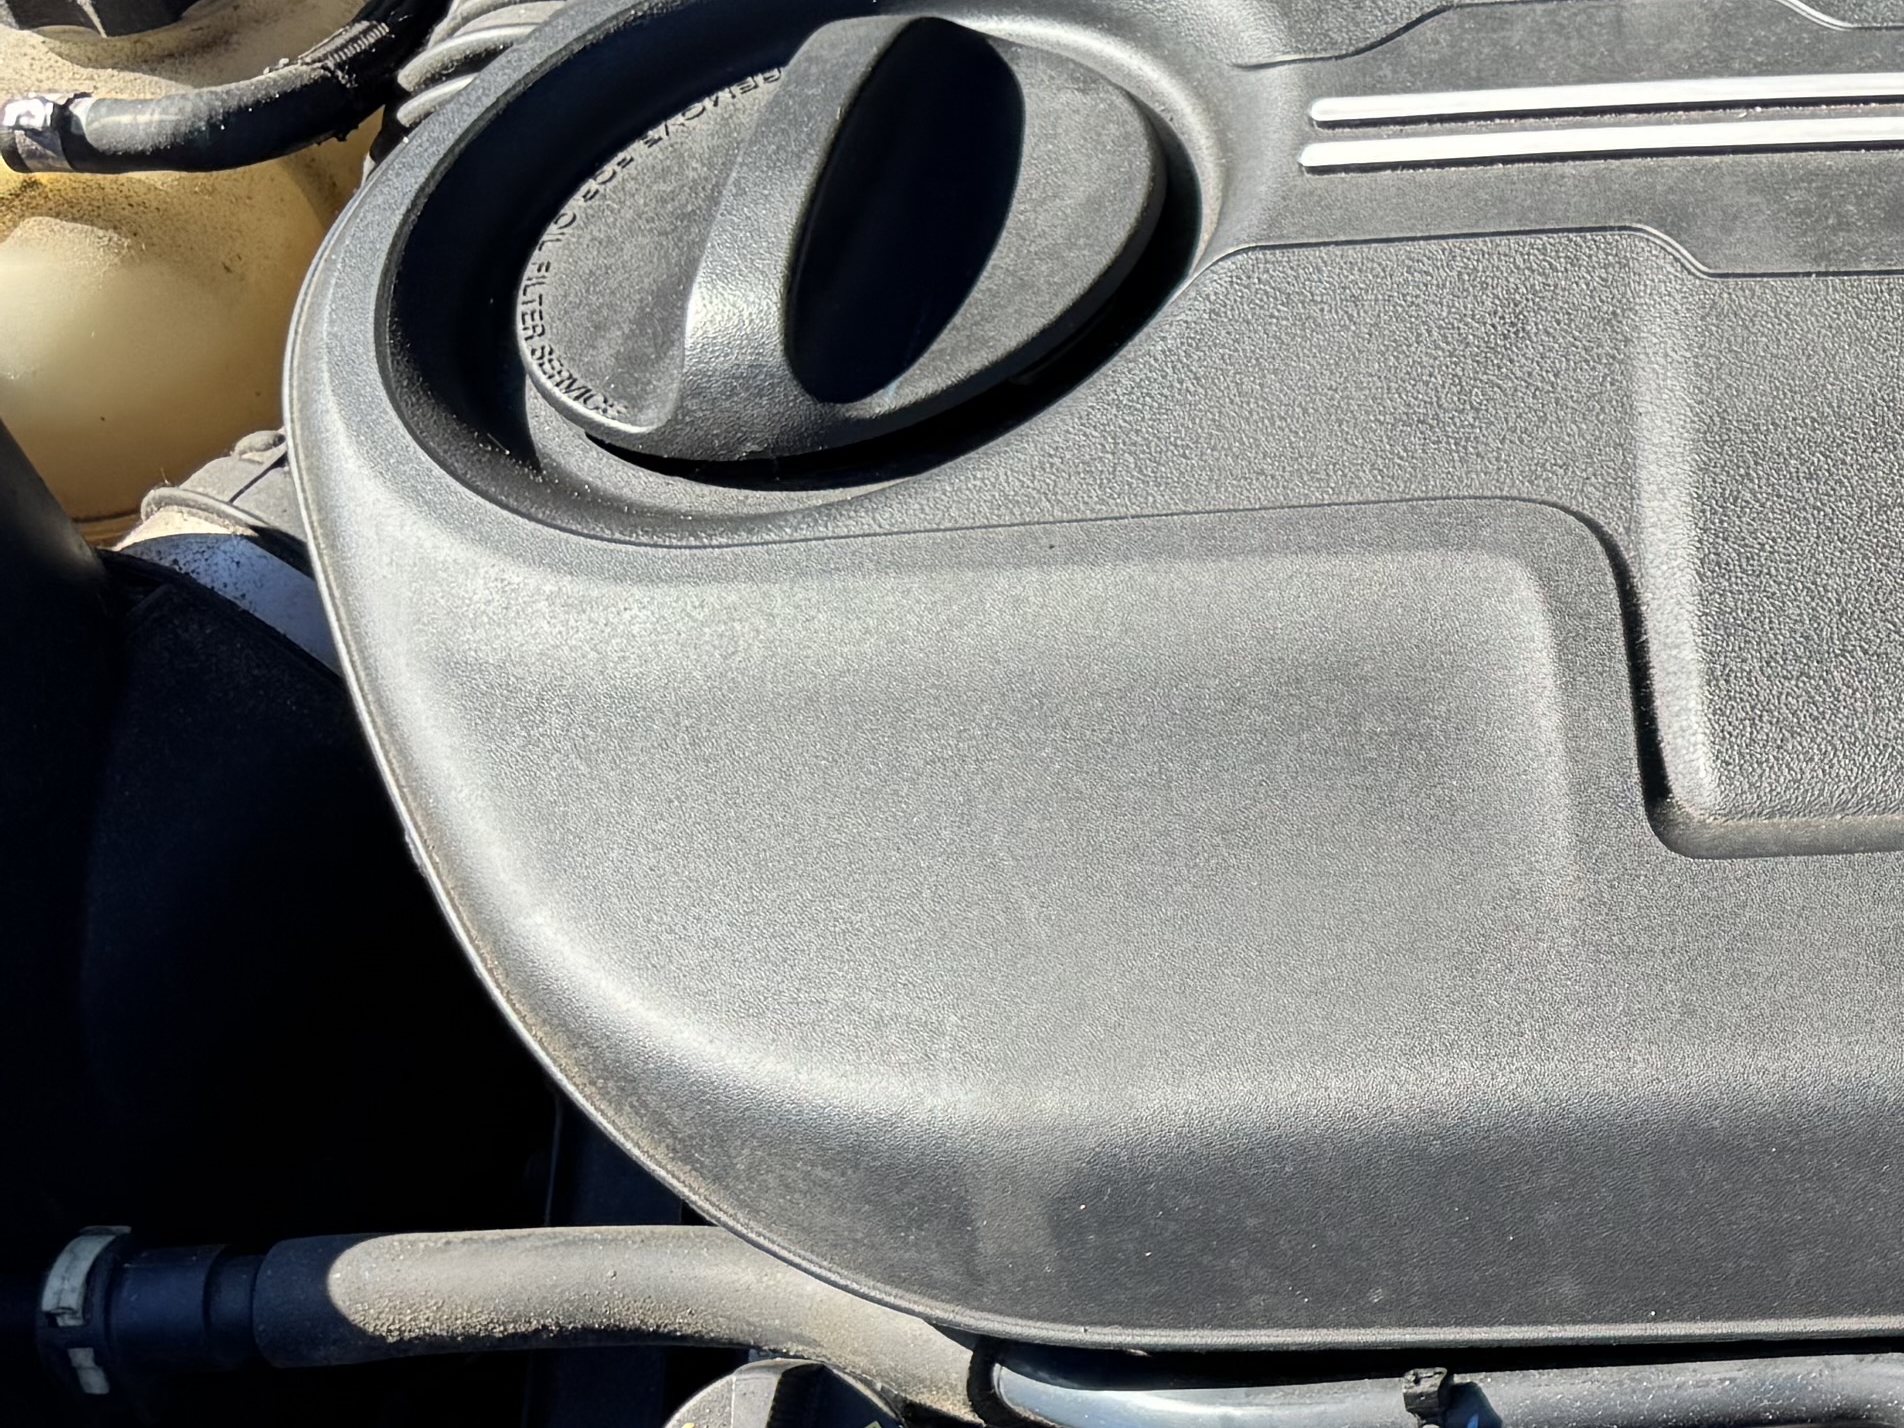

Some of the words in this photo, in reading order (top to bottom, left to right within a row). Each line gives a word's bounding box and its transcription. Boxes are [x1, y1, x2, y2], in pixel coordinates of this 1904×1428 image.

[538, 212, 577, 252] OIL
[520, 261, 551, 341] FILTER
[531, 345, 630, 419] SERVICE
